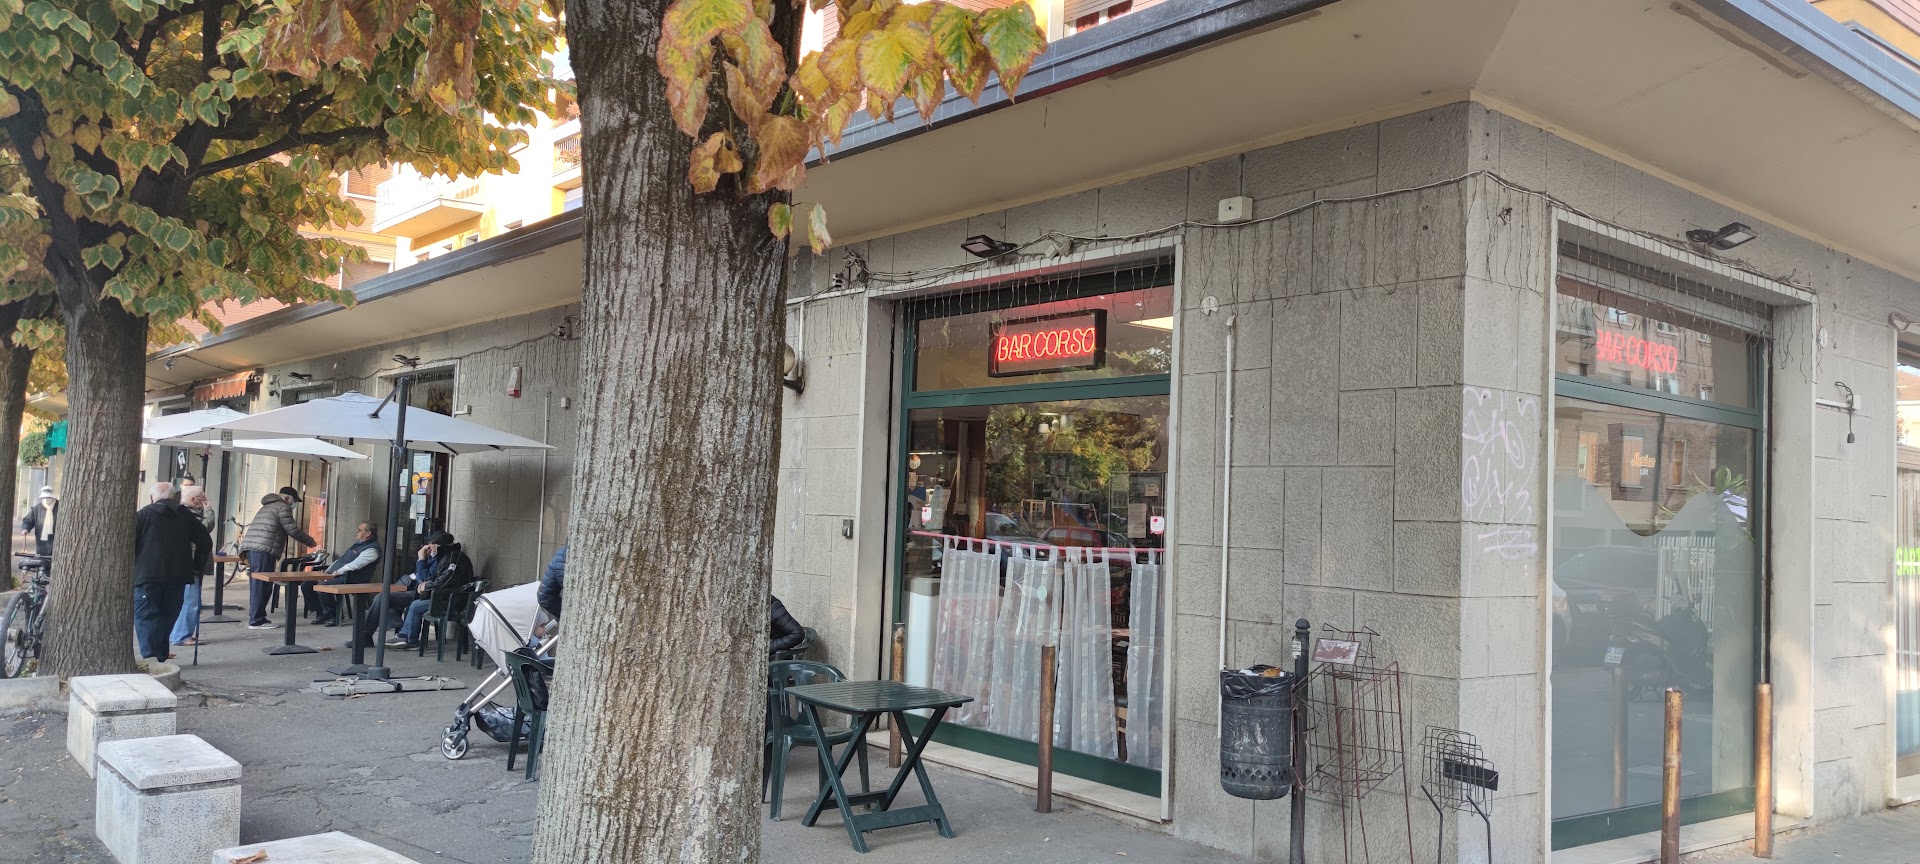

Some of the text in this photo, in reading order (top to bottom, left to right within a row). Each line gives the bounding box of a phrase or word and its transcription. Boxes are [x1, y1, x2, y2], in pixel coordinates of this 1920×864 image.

[998, 327, 1095, 360] BAR CORSO
[1596, 329, 1678, 374] BAR CORSO
